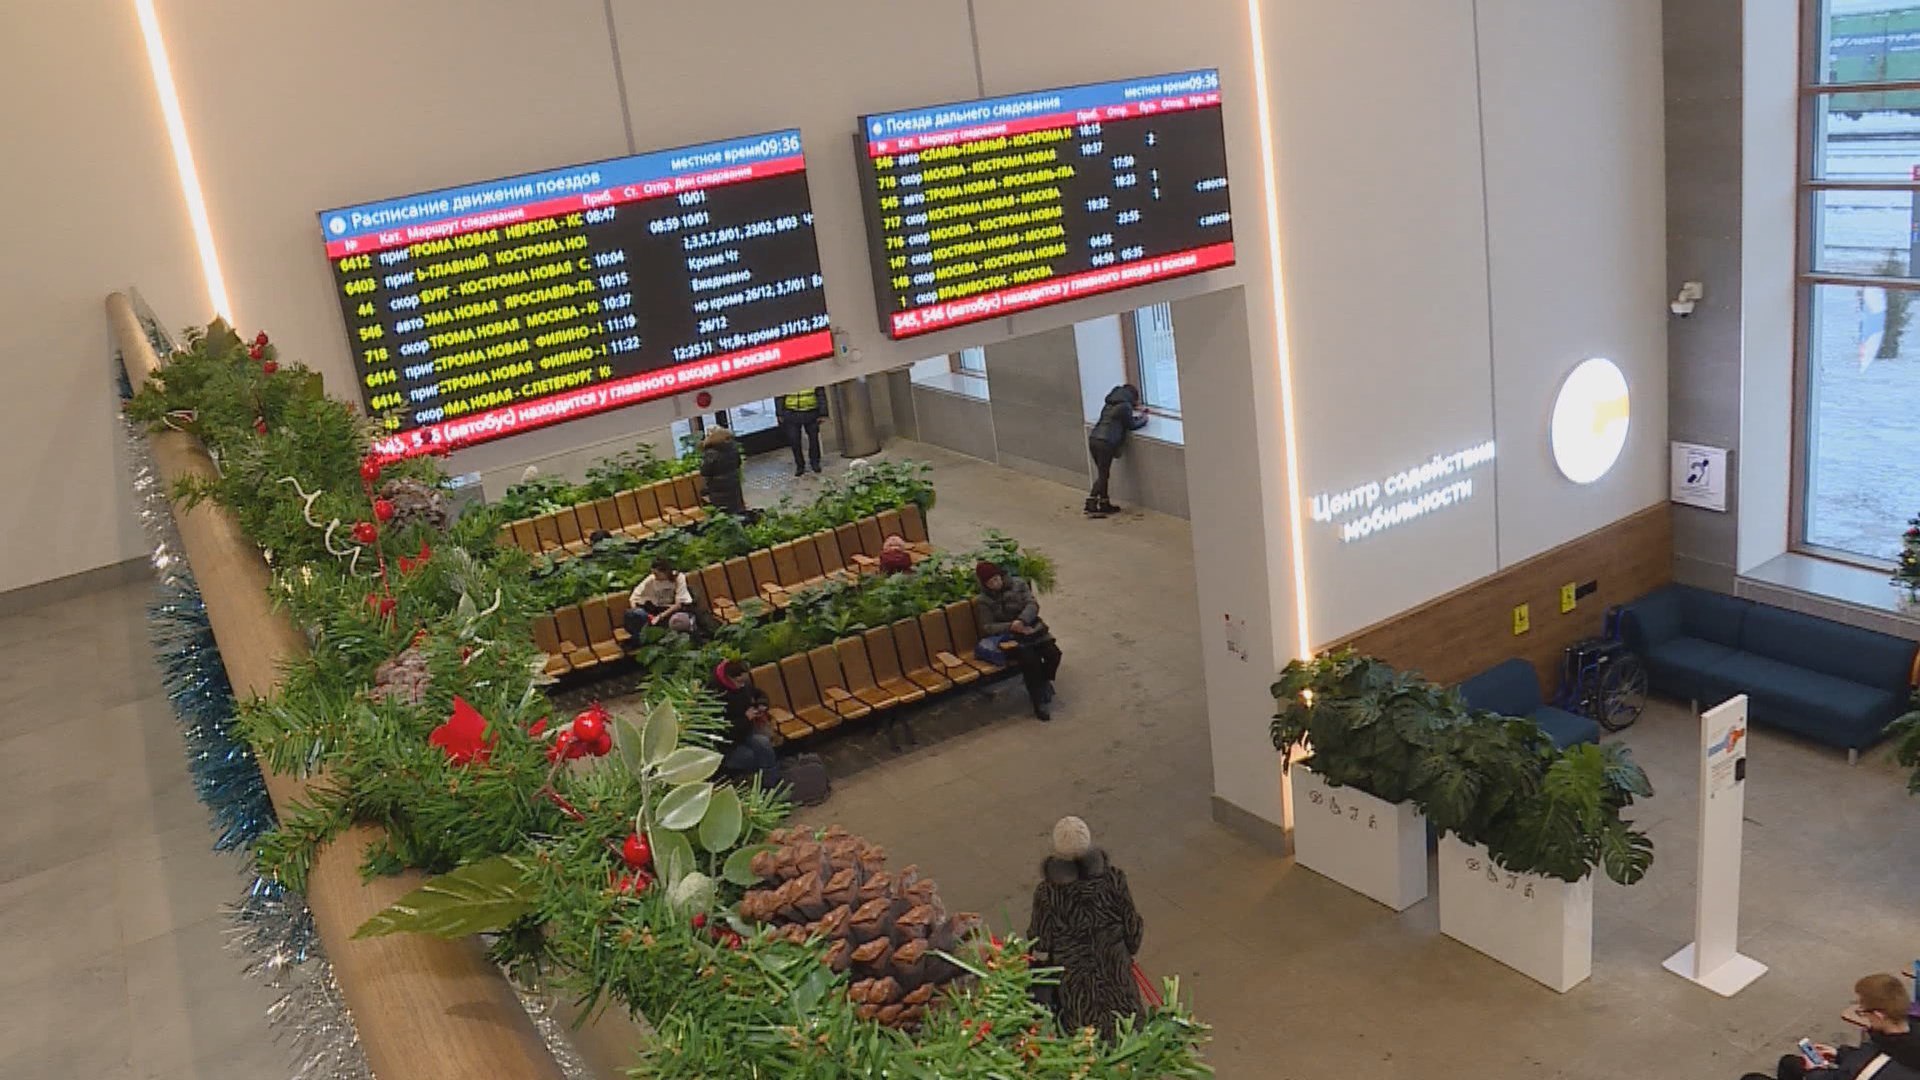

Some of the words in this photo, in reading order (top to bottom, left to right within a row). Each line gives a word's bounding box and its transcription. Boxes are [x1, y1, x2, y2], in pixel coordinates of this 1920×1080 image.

[887, 116, 932, 133] Поезда
[935, 107, 990, 126] дальнего
[993, 97, 1060, 118] следования
[1124, 85, 1161, 98] местное
[671, 151, 722, 170] местное
[724, 145, 760, 163] время
[760, 135, 800, 156] 09:36
[1013, 129, 1064, 147] КОСТРОМА
[878, 175, 896, 190] 718
[901, 173, 922, 187] скор
[924, 164, 965, 182] МОСКВА
[973, 154, 1024, 174] КОСТРОМА
[1024, 148, 1056, 166] НОВАЯ
[881, 196, 899, 210] 545
[963, 177, 997, 195] НОВАЯ
[352, 199, 449, 229] Расписание
[452, 184, 533, 212] движения
[536, 171, 601, 195] поездов
[379, 231, 402, 245] Кат.
[407, 221, 459, 240] Маршрут
[461, 208, 525, 229] следования
[643, 181, 673, 195] Отпр.
[696, 166, 753, 185] следования
[884, 216, 901, 230] 717
[905, 212, 927, 227] скор
[928, 200, 982, 221] КОСТРОМА
[982, 194, 1015, 212] НОВАЯ
[1021, 187, 1061, 204] МОСКВА
[908, 232, 930, 247] скор
[931, 222, 973, 241] МОСКВА
[979, 211, 1031, 231] КОСТРОМА
[1031, 205, 1063, 221] НОВАЯ
[339, 255, 371, 273] 6412
[380, 248, 410, 266] приг
[455, 229, 499, 250] НОВАЯ
[505, 217, 558, 240] НЕРЕХТА
[586, 206, 616, 225] 08:47
[677, 189, 706, 207] 10/01
[344, 278, 376, 296] 6403
[385, 271, 415, 290] приг
[416, 252, 490, 282] Ь-ГЛАВНЫЙ
[496, 238, 565, 265] КОСТРОМА
[650, 216, 680, 234] 08:59
[681, 211, 709, 229] 10/01
[890, 256, 906, 269] 147
[910, 252, 932, 266] скор
[933, 240, 986, 261] КОСТРОМА
[986, 233, 1019, 250] НОВАЯ
[1025, 223, 1065, 242] МОСКВА
[356, 302, 375, 317] 44
[390, 294, 419, 312] скор
[420, 285, 449, 304] БУРГ
[460, 269, 530, 295] КОСТРОМА
[530, 259, 572, 281] НОВАЯ
[595, 250, 625, 269] 10:04
[913, 272, 935, 286] скор
[936, 262, 978, 280] МОСКВА
[984, 249, 1035, 270] КОСТРОМА
[1035, 242, 1066, 259] НОВАЯ
[916, 291, 938, 305] скор
[938, 275, 1008, 300] ВЛАДИВОСТОК
[1014, 265, 1053, 283] МОСКВА
[359, 324, 383, 341] 546
[396, 317, 424, 335] авто
[454, 299, 498, 321] НОВАЯ
[504, 279, 595, 310] ЯРОСЛАВЛЬ-ГЛ.
[599, 271, 629, 290] 10:15
[688, 252, 724, 271] Кроме
[725, 249, 740, 263] Чт
[364, 347, 388, 364] 718
[400, 340, 430, 357] скор
[476, 317, 520, 340] НОВАЯ
[526, 305, 579, 328] МОСКВА
[602, 293, 632, 311] 10:37
[691, 270, 751, 292] Ежедневно
[946, 296, 1000, 320] (автобус)
[1002, 286, 1061, 306] находится
[366, 369, 397, 388] 6414
[405, 361, 434, 380] приг
[486, 338, 529, 361] НОВАЯ
[535, 325, 590, 348] ФИЛИНО
[606, 314, 637, 333] 11:19
[694, 301, 709, 313] но
[710, 293, 744, 311] кроме
[371, 391, 402, 410] 6414
[410, 383, 440, 402] приг
[491, 359, 534, 381] НОВАЯ
[540, 346, 594, 370] ФИЛИНО
[610, 336, 640, 355] 11:22
[699, 316, 728, 334] 26/12
[412, 427, 442, 449] 56
[443, 408, 516, 441] (автобус)
[519, 387, 597, 422] находится
[599, 386, 607, 406] у
[609, 372, 675, 399] главного
[677, 363, 721, 385] входа
[723, 361, 732, 373] в
[733, 348, 781, 369] вокзал
[416, 406, 444, 423] скор
[470, 388, 513, 409] НОВАЯ
[521, 368, 593, 397] С.ПЕТЕРБУРГ
[672, 343, 701, 362] 12:25
[747, 329, 781, 347] кроме
[1312, 481, 1380, 522] Центр
[1384, 439, 1495, 496] содействия
[1343, 478, 1473, 543] мобильности
